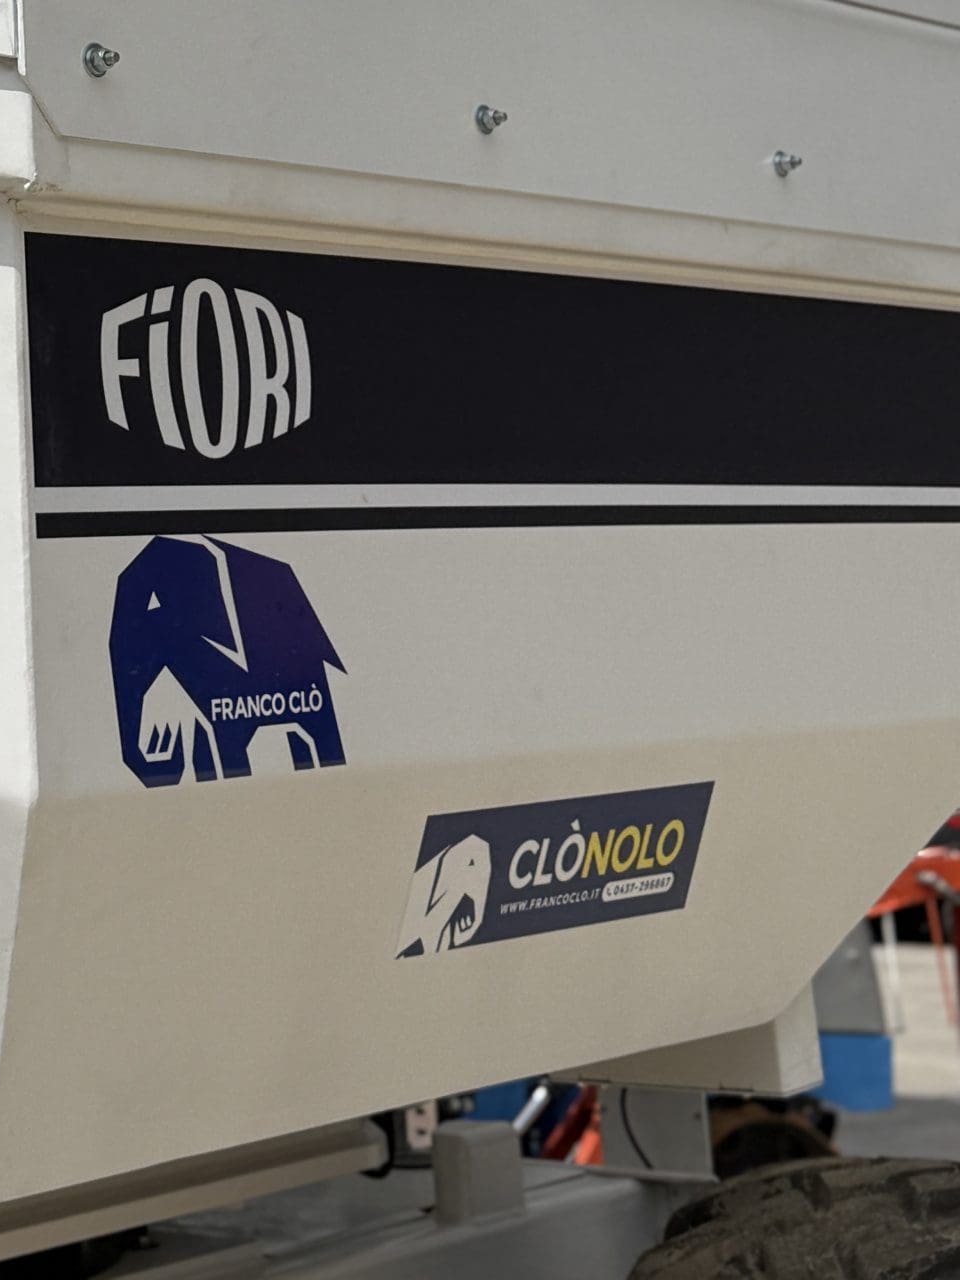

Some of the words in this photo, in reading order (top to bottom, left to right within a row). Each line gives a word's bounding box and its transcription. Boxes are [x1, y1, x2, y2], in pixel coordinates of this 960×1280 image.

[211, 692, 286, 722] FRANCO
[288, 683, 324, 715] CLÒ
[508, 818, 686, 889] CLÒNOLO
[500, 888, 601, 914] WWW.FRANCOCLO.IT
